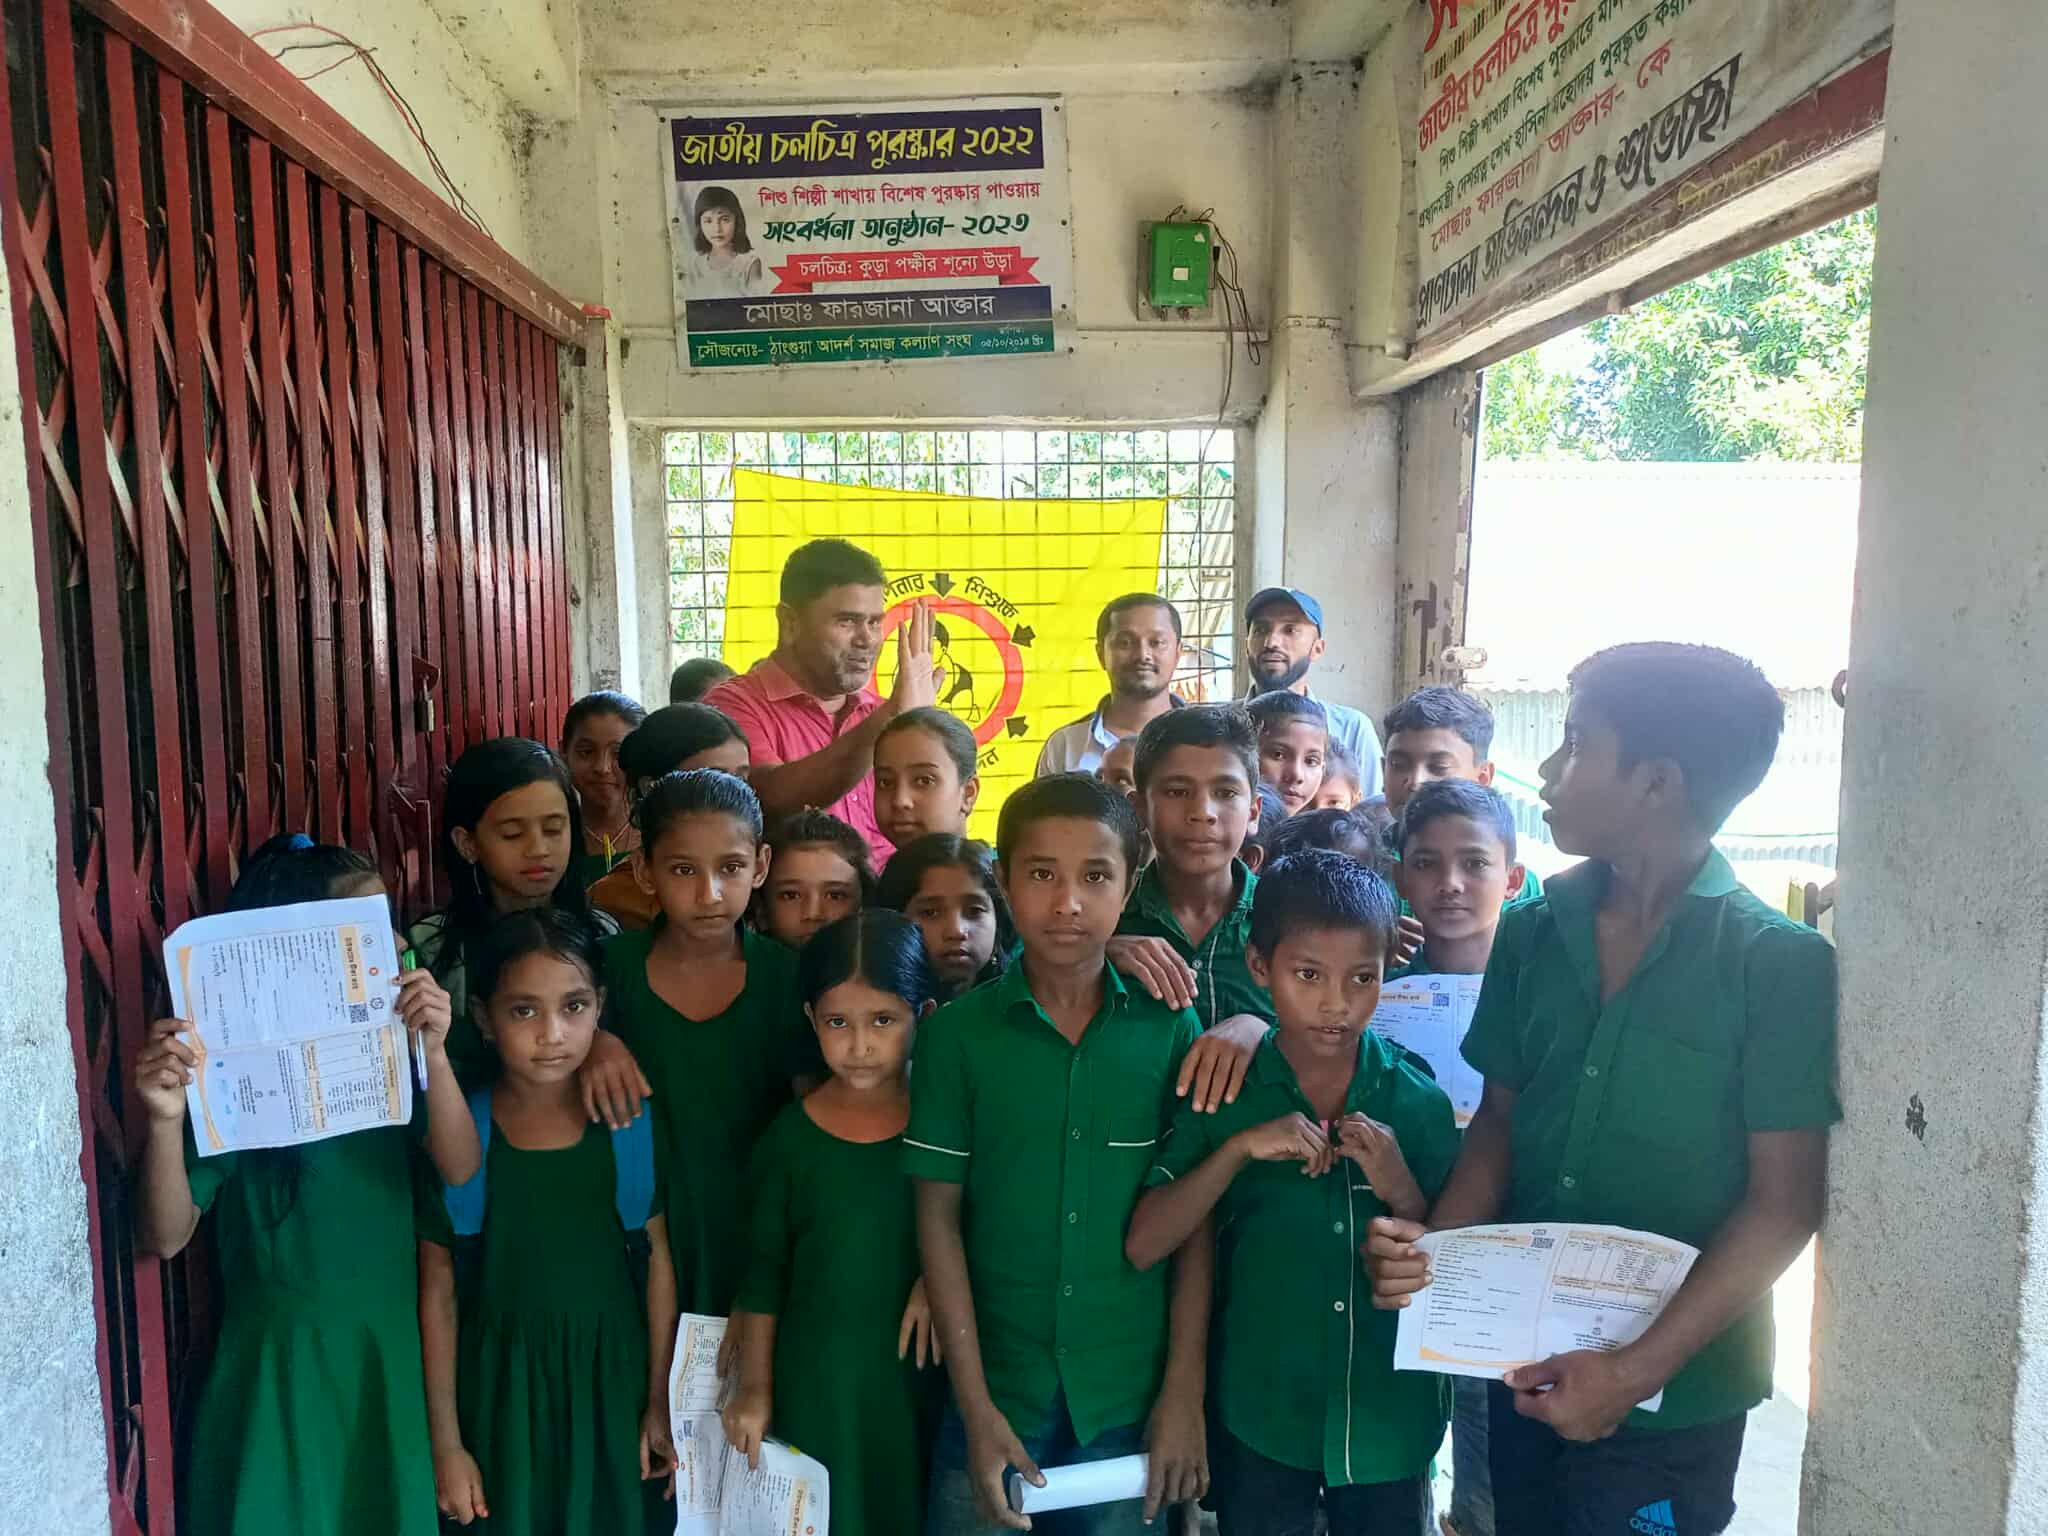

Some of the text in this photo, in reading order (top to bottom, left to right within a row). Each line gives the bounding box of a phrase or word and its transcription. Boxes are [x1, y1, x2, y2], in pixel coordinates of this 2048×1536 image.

[1418, 70, 1470, 151] জাতীয়
[1476, 143, 1544, 216] ফারজানা
[1636, 37, 1673, 89] কে
[680, 122, 763, 165] জাতীয়
[771, 119, 860, 163] চলচিত্র
[962, 126, 1034, 157] ২০২২
[758, 186, 788, 207] শিশু
[792, 184, 827, 206] শিল্পী
[832, 187, 876, 205] শাখায়
[880, 182, 927, 203] বিশেষ
[986, 181, 1041, 199] পাওয়ায়
[763, 211, 855, 243] সংবর্ধনা
[962, 213, 1030, 236] ২০২৩
[858, 258, 889, 278] কুড়া
[895, 252, 938, 273] পক্ষীর
[983, 251, 1013, 272] উড়া
[742, 293, 997, 323] মোছাঃ ফারজানা আক্তার
[816, 334, 855, 354] আদর্শ
[858, 336, 896, 352] সমাজ
[945, 333, 973, 349] সংঘ
[883, 573, 1019, 618] পনার শিশুকে
